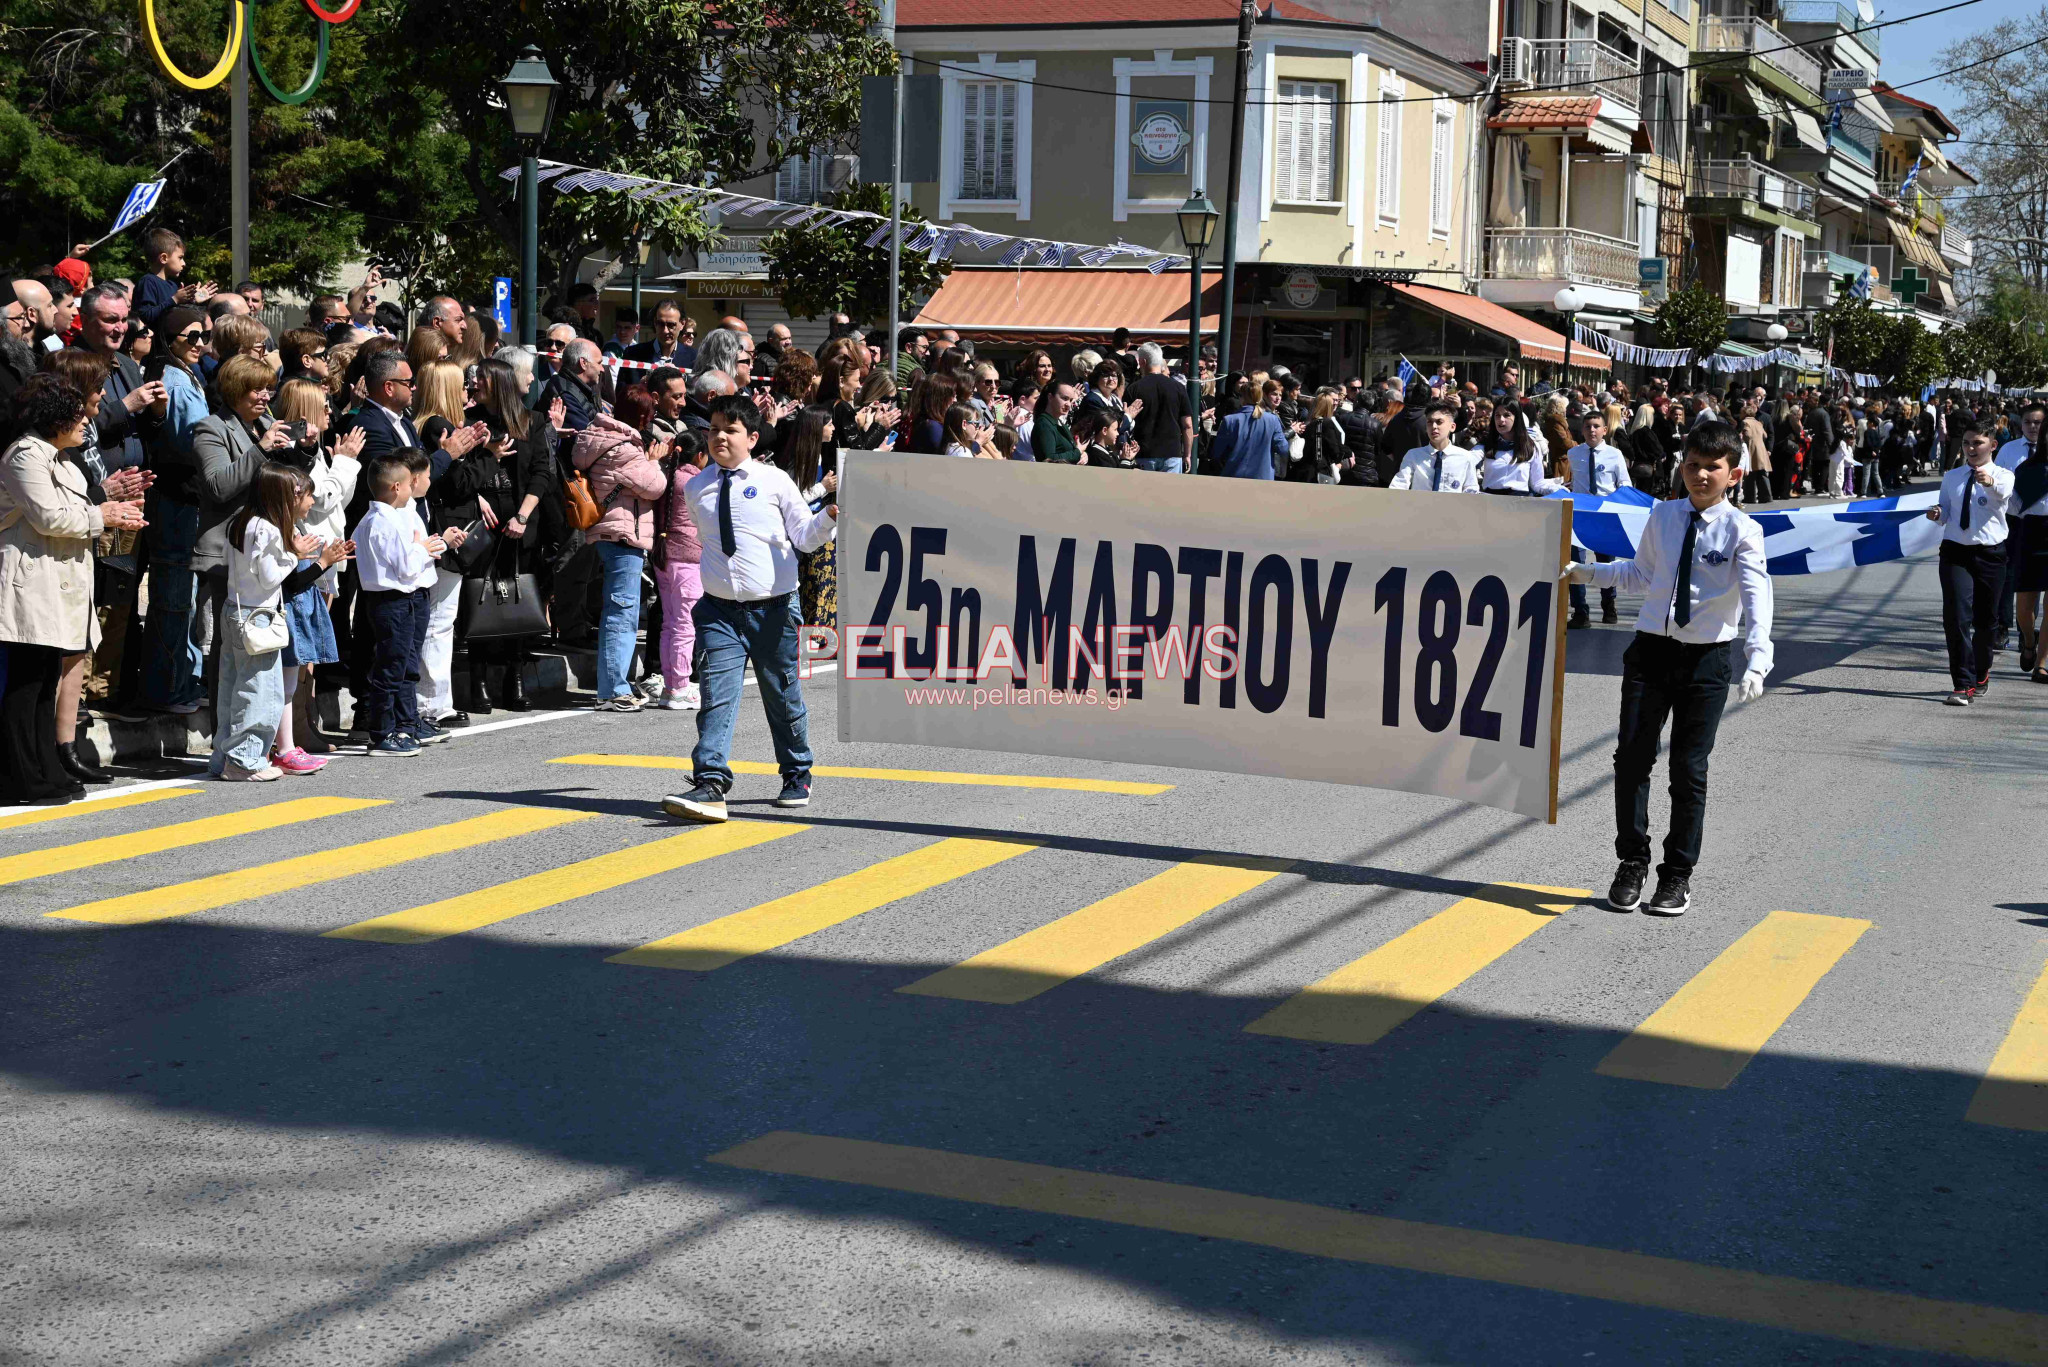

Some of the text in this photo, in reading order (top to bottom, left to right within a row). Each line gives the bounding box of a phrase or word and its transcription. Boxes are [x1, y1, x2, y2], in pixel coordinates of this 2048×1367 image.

[707, 253, 762, 267] Σιδηρόπο
[496, 281, 508, 310] P
[698, 281, 749, 296] Ρολόγια
[1012, 534, 1353, 719] ΜΑΡΤΙΟΥ
[1374, 566, 1552, 748] 1821
